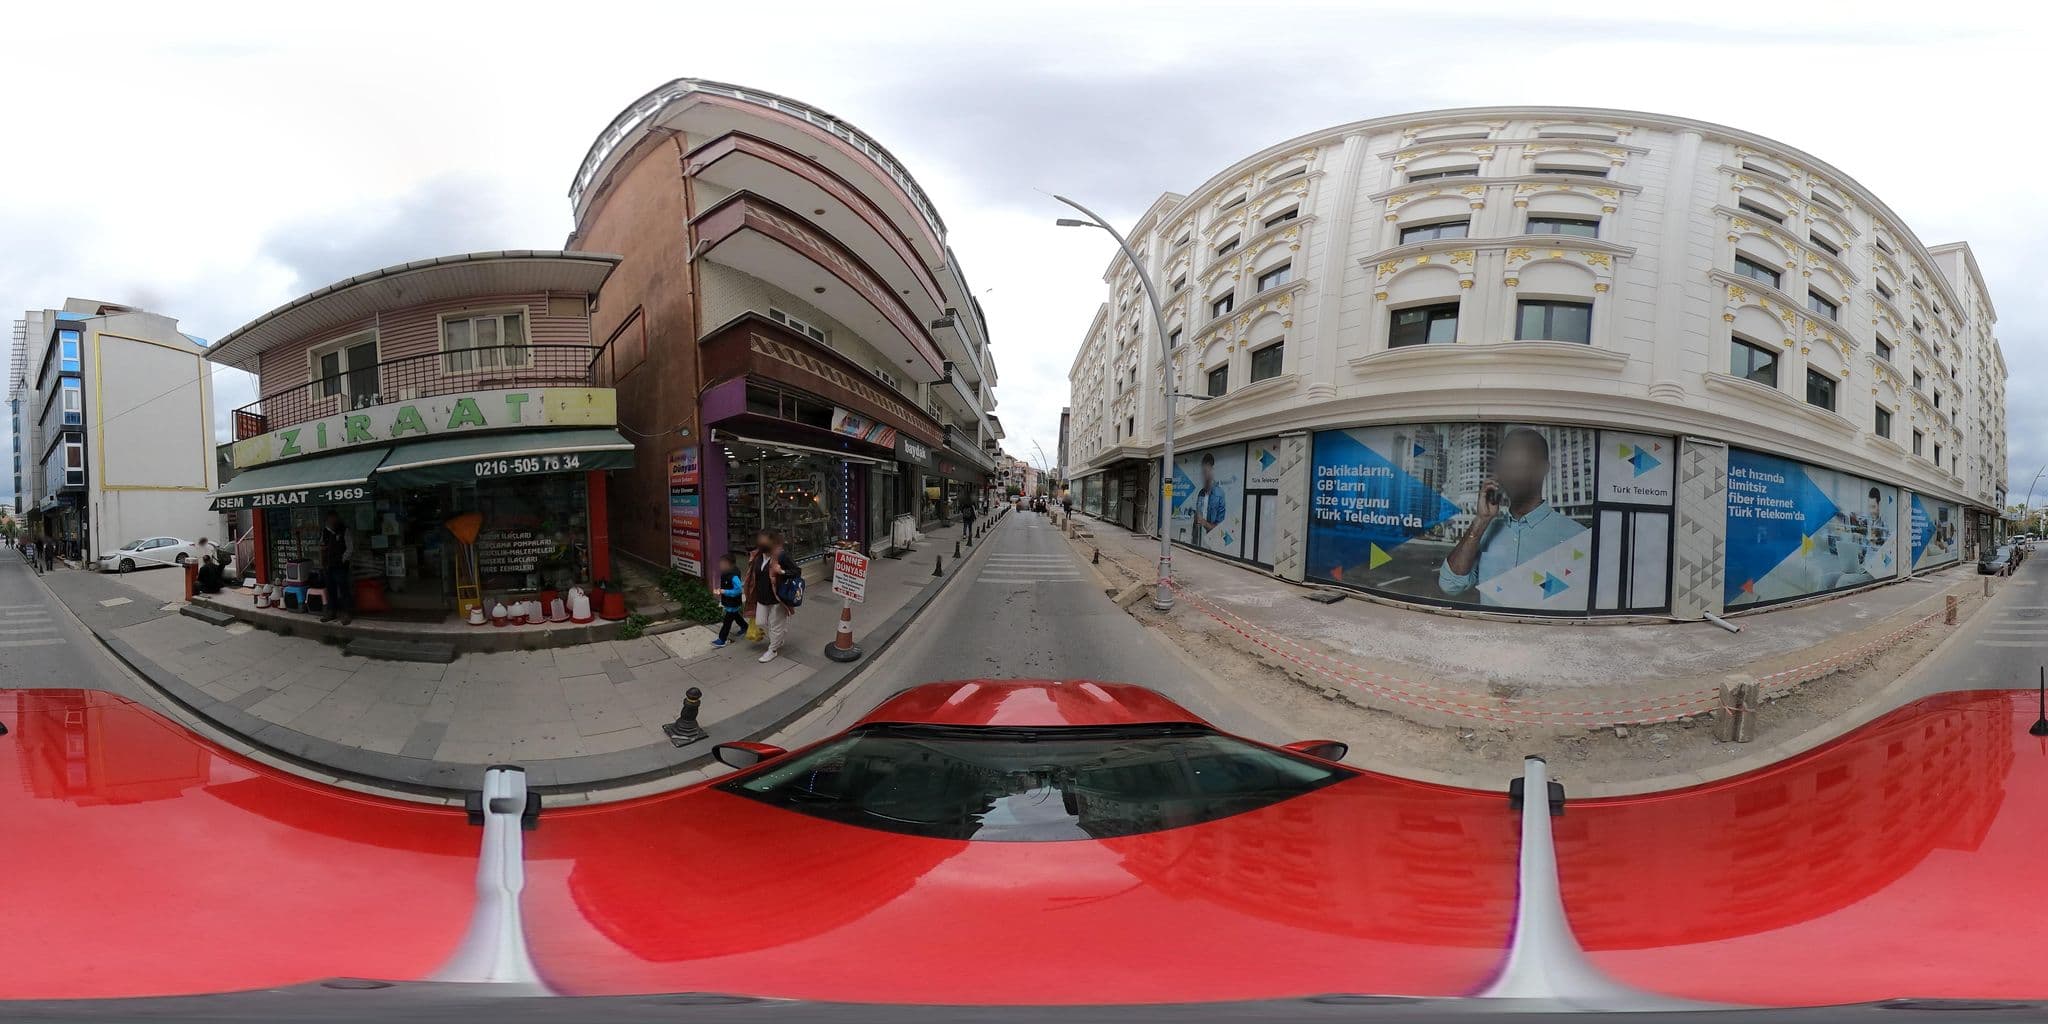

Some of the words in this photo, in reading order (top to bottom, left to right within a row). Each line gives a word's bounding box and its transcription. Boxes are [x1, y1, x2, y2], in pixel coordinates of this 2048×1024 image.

[543, 456, 560, 471] 76
[563, 454, 580, 469] 34
[1318, 464, 1394, 478] Dakikaların,
[1728, 466, 1746, 479] Jet
[1749, 468, 1785, 484] hızında
[1612, 485, 1631, 494] Türk
[1634, 486, 1668, 497] Telekom
[1728, 479, 1767, 493] limitsiz
[253, 491, 309, 507] ZİRAAT
[1316, 494, 1339, 506] size
[1341, 497, 1390, 510] uygunu
[1728, 492, 1754, 506] fiber
[1757, 496, 1794, 508] internet
[1315, 508, 1341, 521] Türk
[1728, 505, 1752, 518] Türk
[840, 554, 863, 567] ANNE
